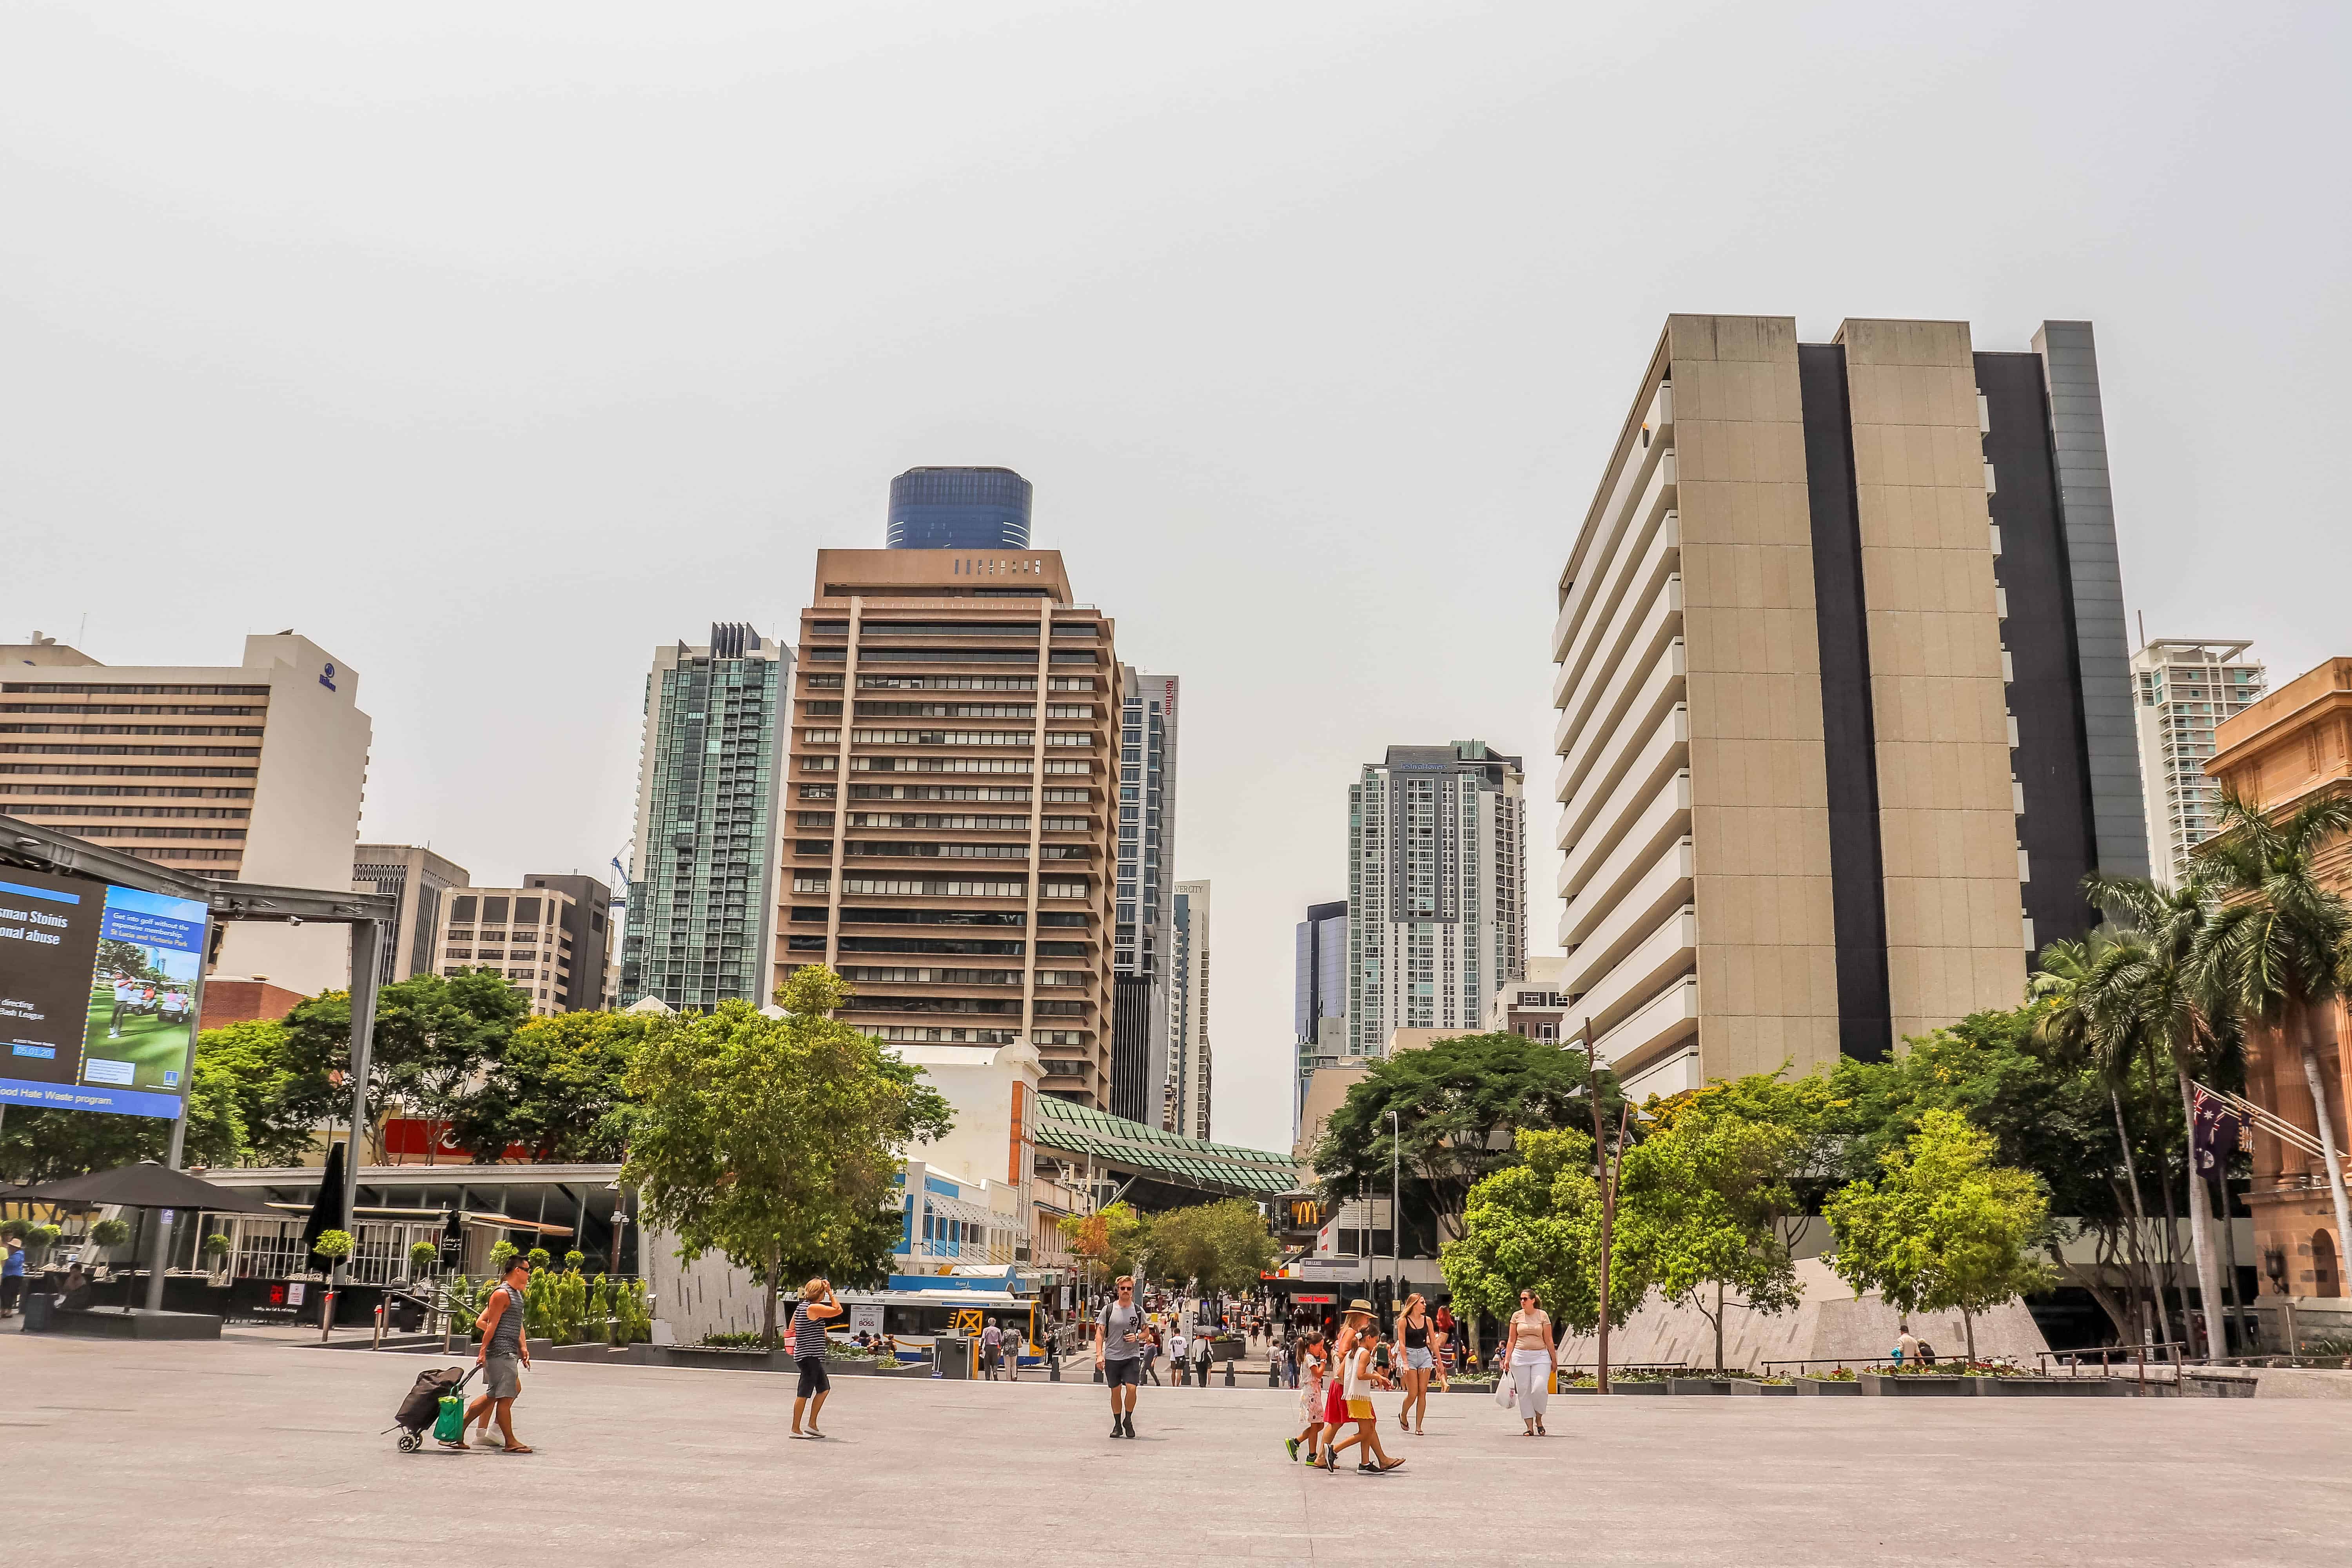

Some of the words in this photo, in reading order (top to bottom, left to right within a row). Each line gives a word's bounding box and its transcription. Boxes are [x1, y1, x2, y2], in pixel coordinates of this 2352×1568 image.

[29, 911, 68, 928] Stoinis
[154, 920, 178, 929] without
[112, 922, 143, 931] expensive
[144, 927, 183, 938] membership.
[25, 929, 60, 945] abuse
[150, 935, 173, 944] Victoria
[2, 999, 34, 1010] directing
[19, 1010, 44, 1020] League
[20, 1088, 42, 1098] Hate
[45, 1091, 73, 1101] Waste
[75, 1096, 114, 1105] program.
